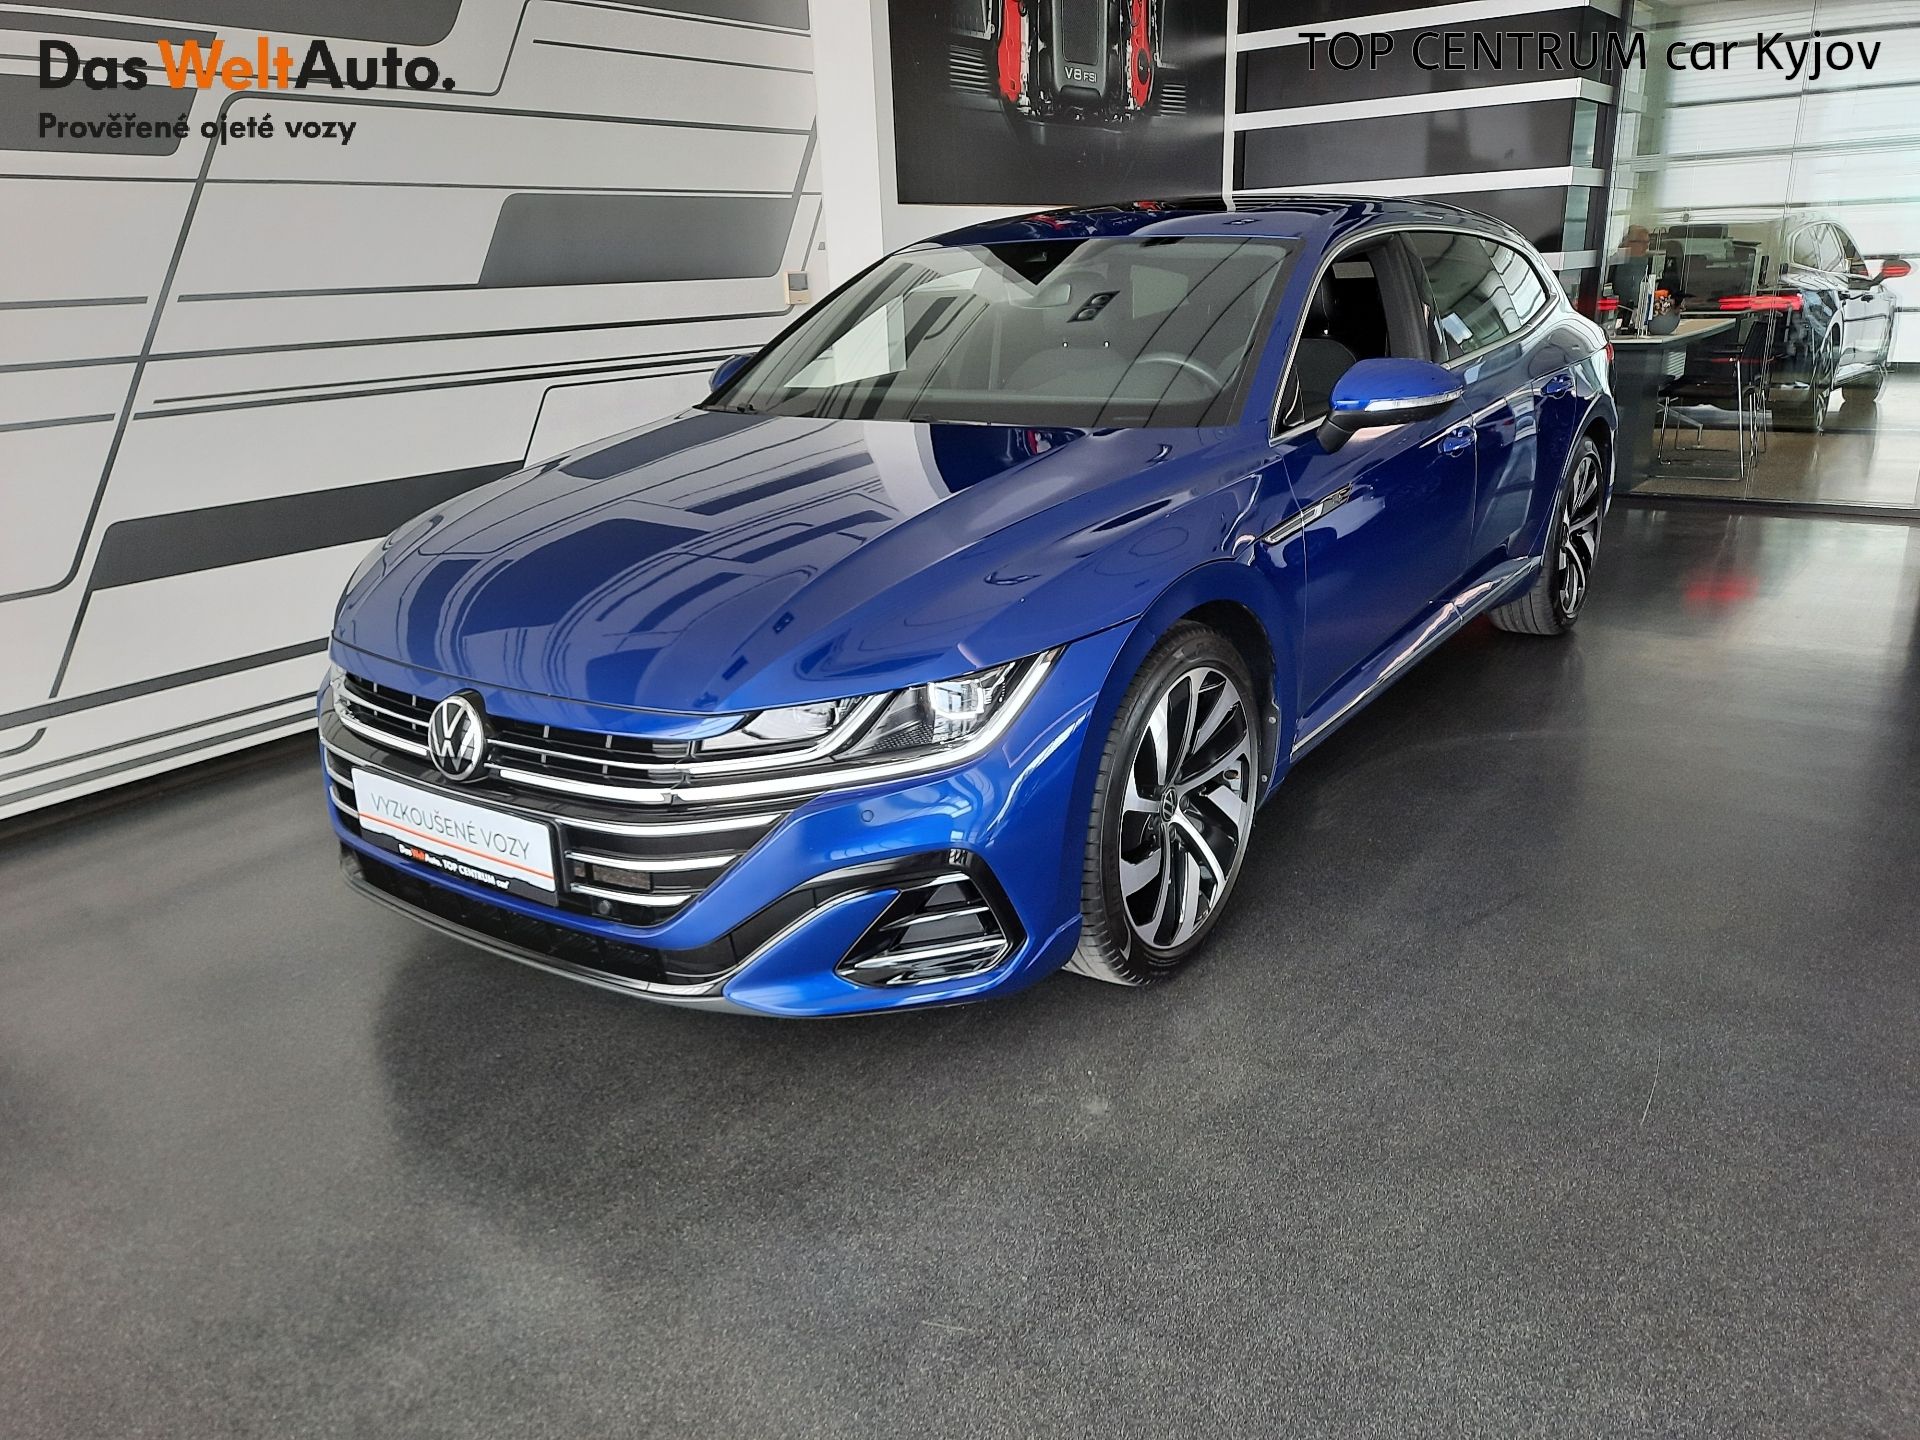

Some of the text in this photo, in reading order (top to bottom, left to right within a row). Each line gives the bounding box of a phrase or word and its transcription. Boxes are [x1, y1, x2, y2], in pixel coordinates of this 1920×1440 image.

[1064, 66, 1097, 83] V8 FSI
[371, 792, 531, 861] VYZKOUŠENÉ VOZY
[442, 859, 458, 873] TOP
